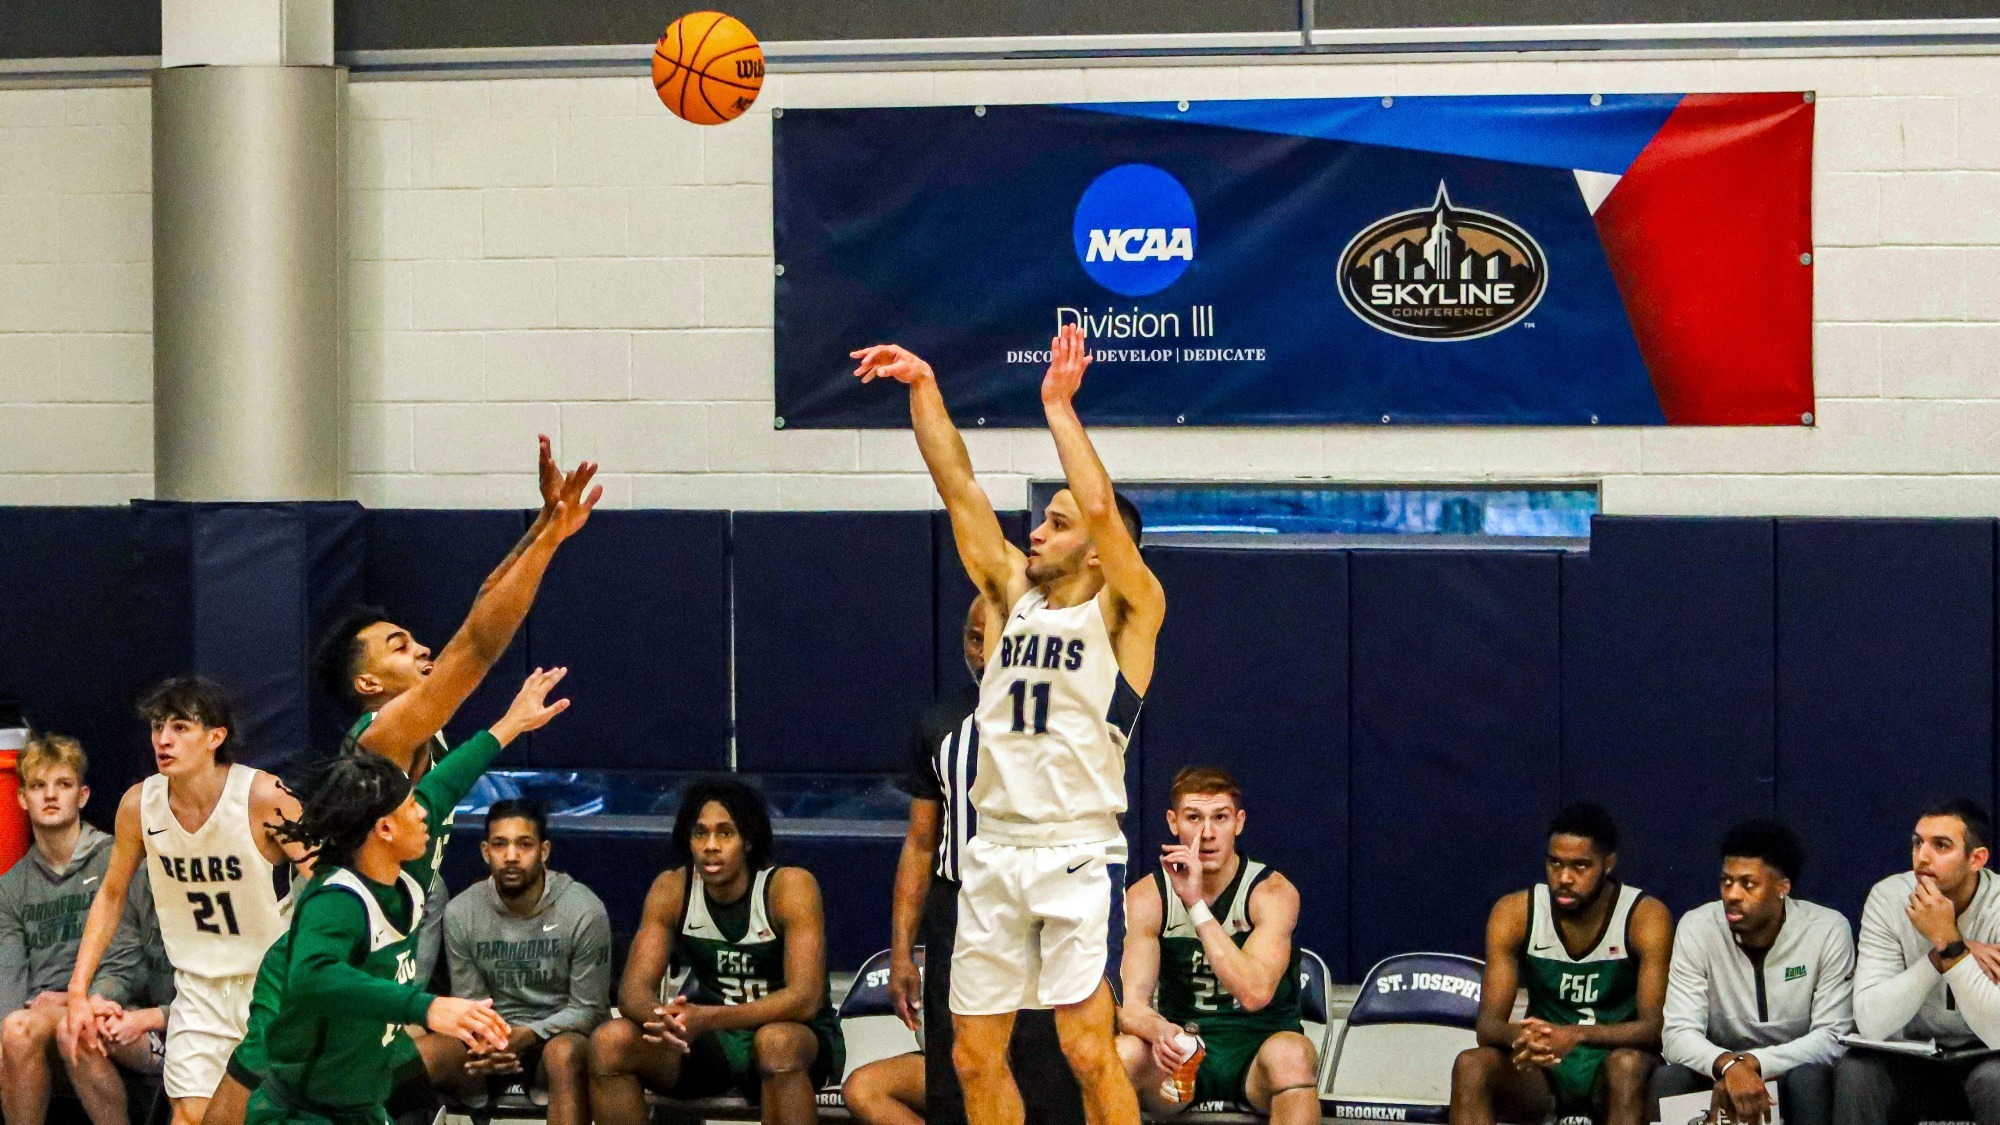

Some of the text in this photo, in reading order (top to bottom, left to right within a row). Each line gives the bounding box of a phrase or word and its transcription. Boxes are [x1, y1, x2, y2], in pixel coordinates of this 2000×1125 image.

[1086, 228, 1193, 262] NCAA
[1371, 283, 1515, 305] SKYLINE
[1057, 305, 1214, 338] Division III
[1392, 307, 1494, 317] CONFERENCE
[1096, 350, 1172, 362] DEVELOP
[1184, 349, 1266, 361] DEDICATE
[1001, 633, 1086, 672] BEARS
[1009, 678, 1052, 735] 11
[159, 854, 243, 883] BEARS
[186, 891, 240, 935] 21
[717, 950, 754, 975] FSC
[1376, 973, 1408, 994] ST.
[1559, 972, 1600, 1003] FSC
[1335, 1105, 1406, 1121] BROOKLYN
